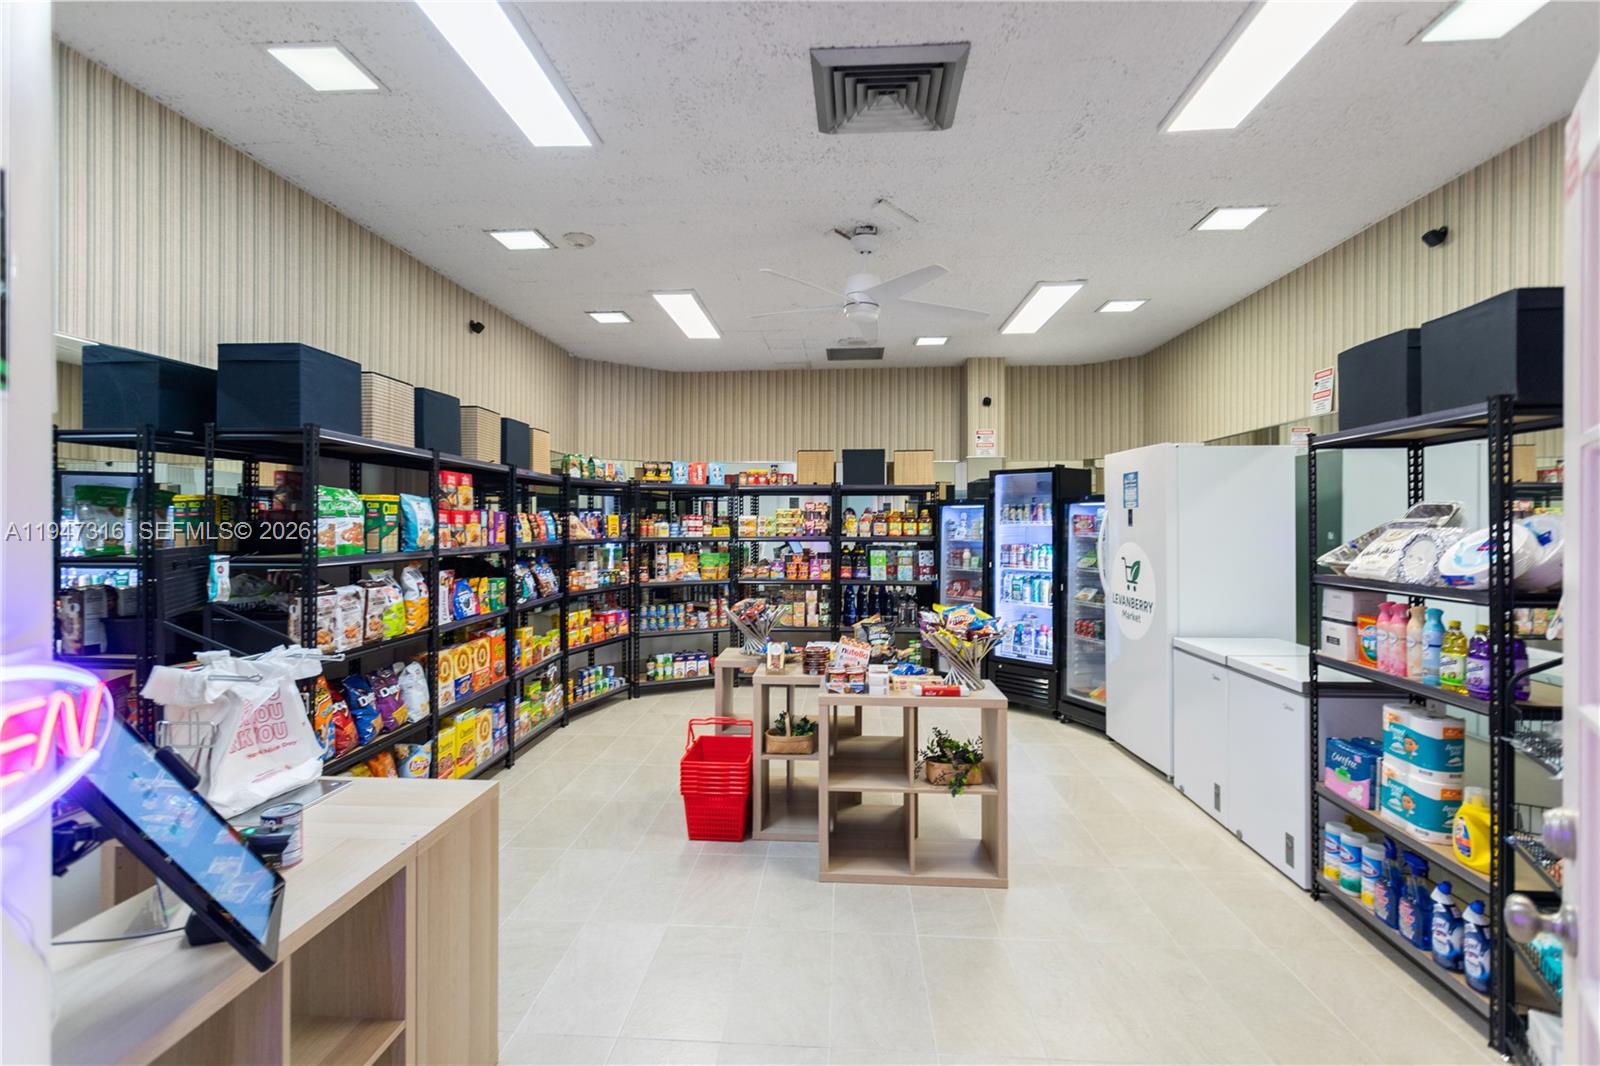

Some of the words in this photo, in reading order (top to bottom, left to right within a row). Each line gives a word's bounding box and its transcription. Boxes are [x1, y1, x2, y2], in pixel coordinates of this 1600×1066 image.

[1112, 593, 1153, 614] LEVANBERRY
[1121, 609, 1142, 624] Market
[842, 647, 869, 660] nutella
